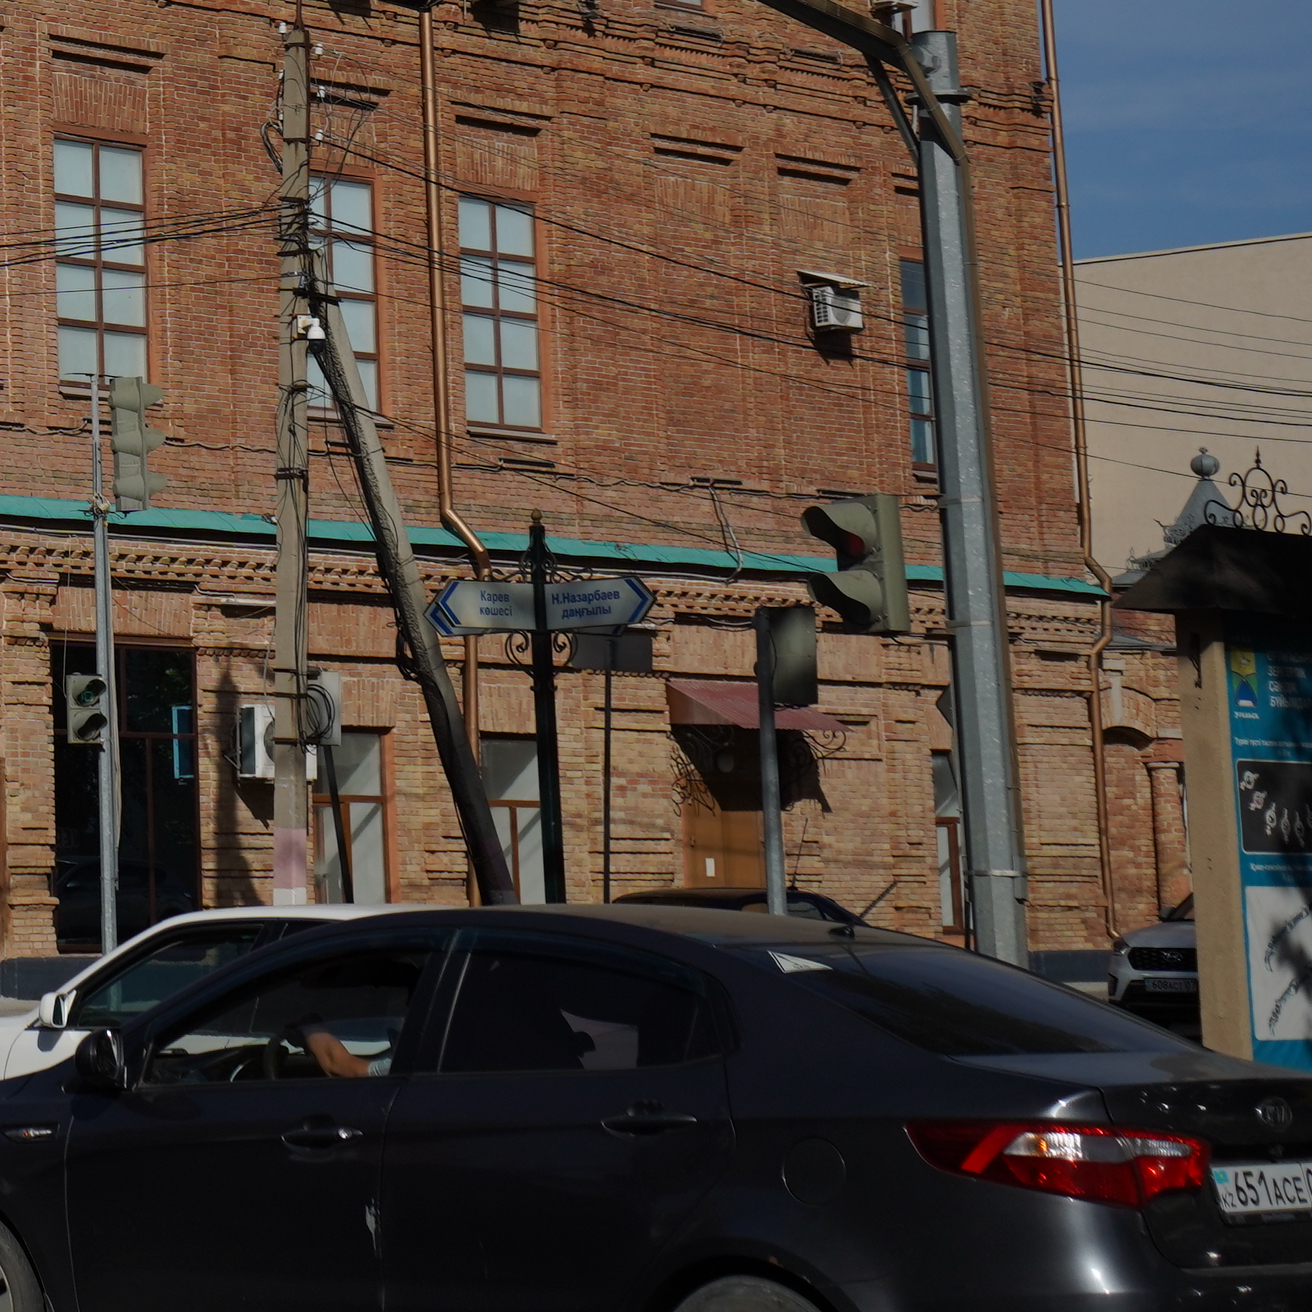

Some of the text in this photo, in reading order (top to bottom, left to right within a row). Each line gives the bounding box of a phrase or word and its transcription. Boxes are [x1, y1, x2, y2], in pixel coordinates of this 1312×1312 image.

[480, 590, 510, 604] Карев
[551, 589, 620, 605] Н.Назарбаев
[479, 605, 513, 616] көшесі
[562, 605, 612, 620] даңғылы
[1233, 1170, 1308, 1207] 651ACE
